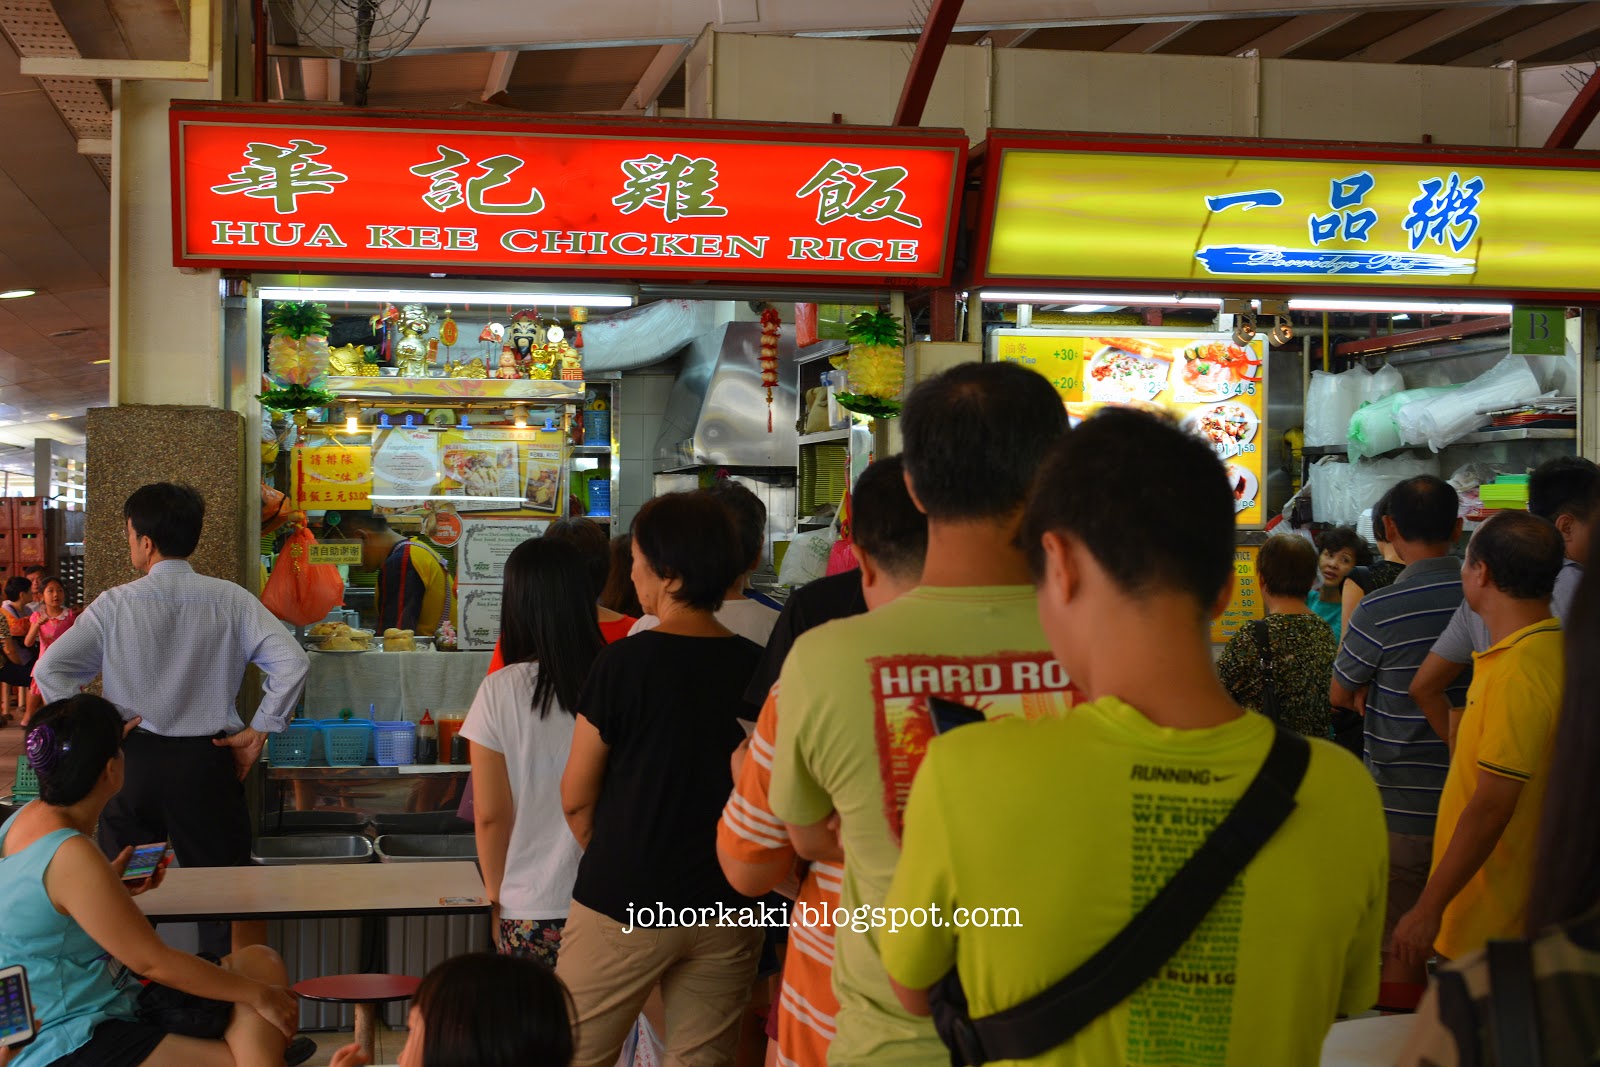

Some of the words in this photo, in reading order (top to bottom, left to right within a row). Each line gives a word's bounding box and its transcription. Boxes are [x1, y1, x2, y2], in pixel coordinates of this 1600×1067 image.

[212, 221, 347, 248] HUA
[366, 225, 478, 251] KEE
[500, 229, 770, 258] CHICKEN
[788, 236, 919, 262] RICE
[1247, 251, 1360, 274] Porridge
[1366, 254, 1416, 270] Pot
[1529, 313, 1549, 340] B
[880, 663, 1002, 695] HARD
[1130, 764, 1211, 785] RUNNING
[1134, 811, 1164, 825] WE
[1171, 813, 1217, 827] RUN
[1166, 970, 1209, 985] RUN
[1215, 972, 1237, 986] SG
